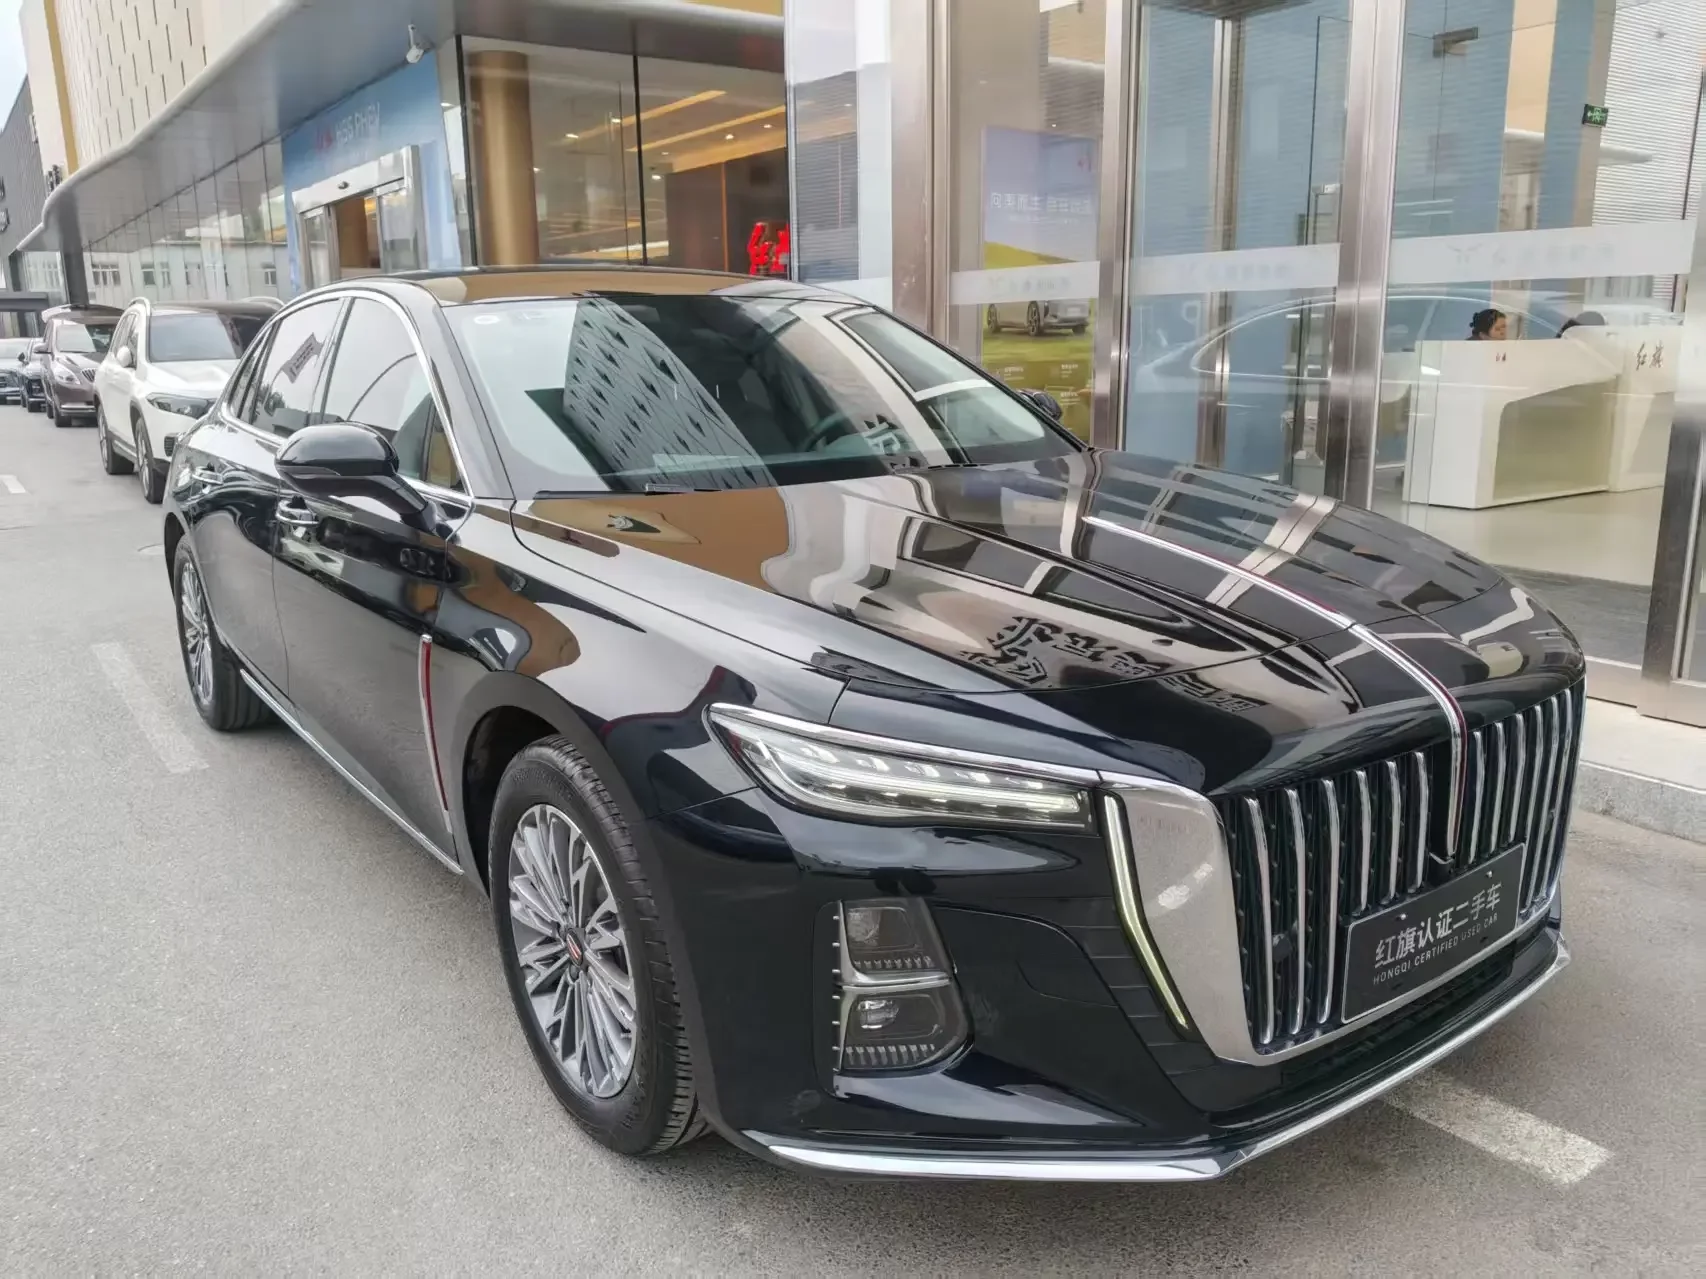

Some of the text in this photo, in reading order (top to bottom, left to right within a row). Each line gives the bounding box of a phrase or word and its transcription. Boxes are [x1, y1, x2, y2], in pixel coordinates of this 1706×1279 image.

[1373, 912, 1498, 985] HONGQI CERTIFIED USED CAR
[1374, 882, 1502, 969] 红旗认证二手车
